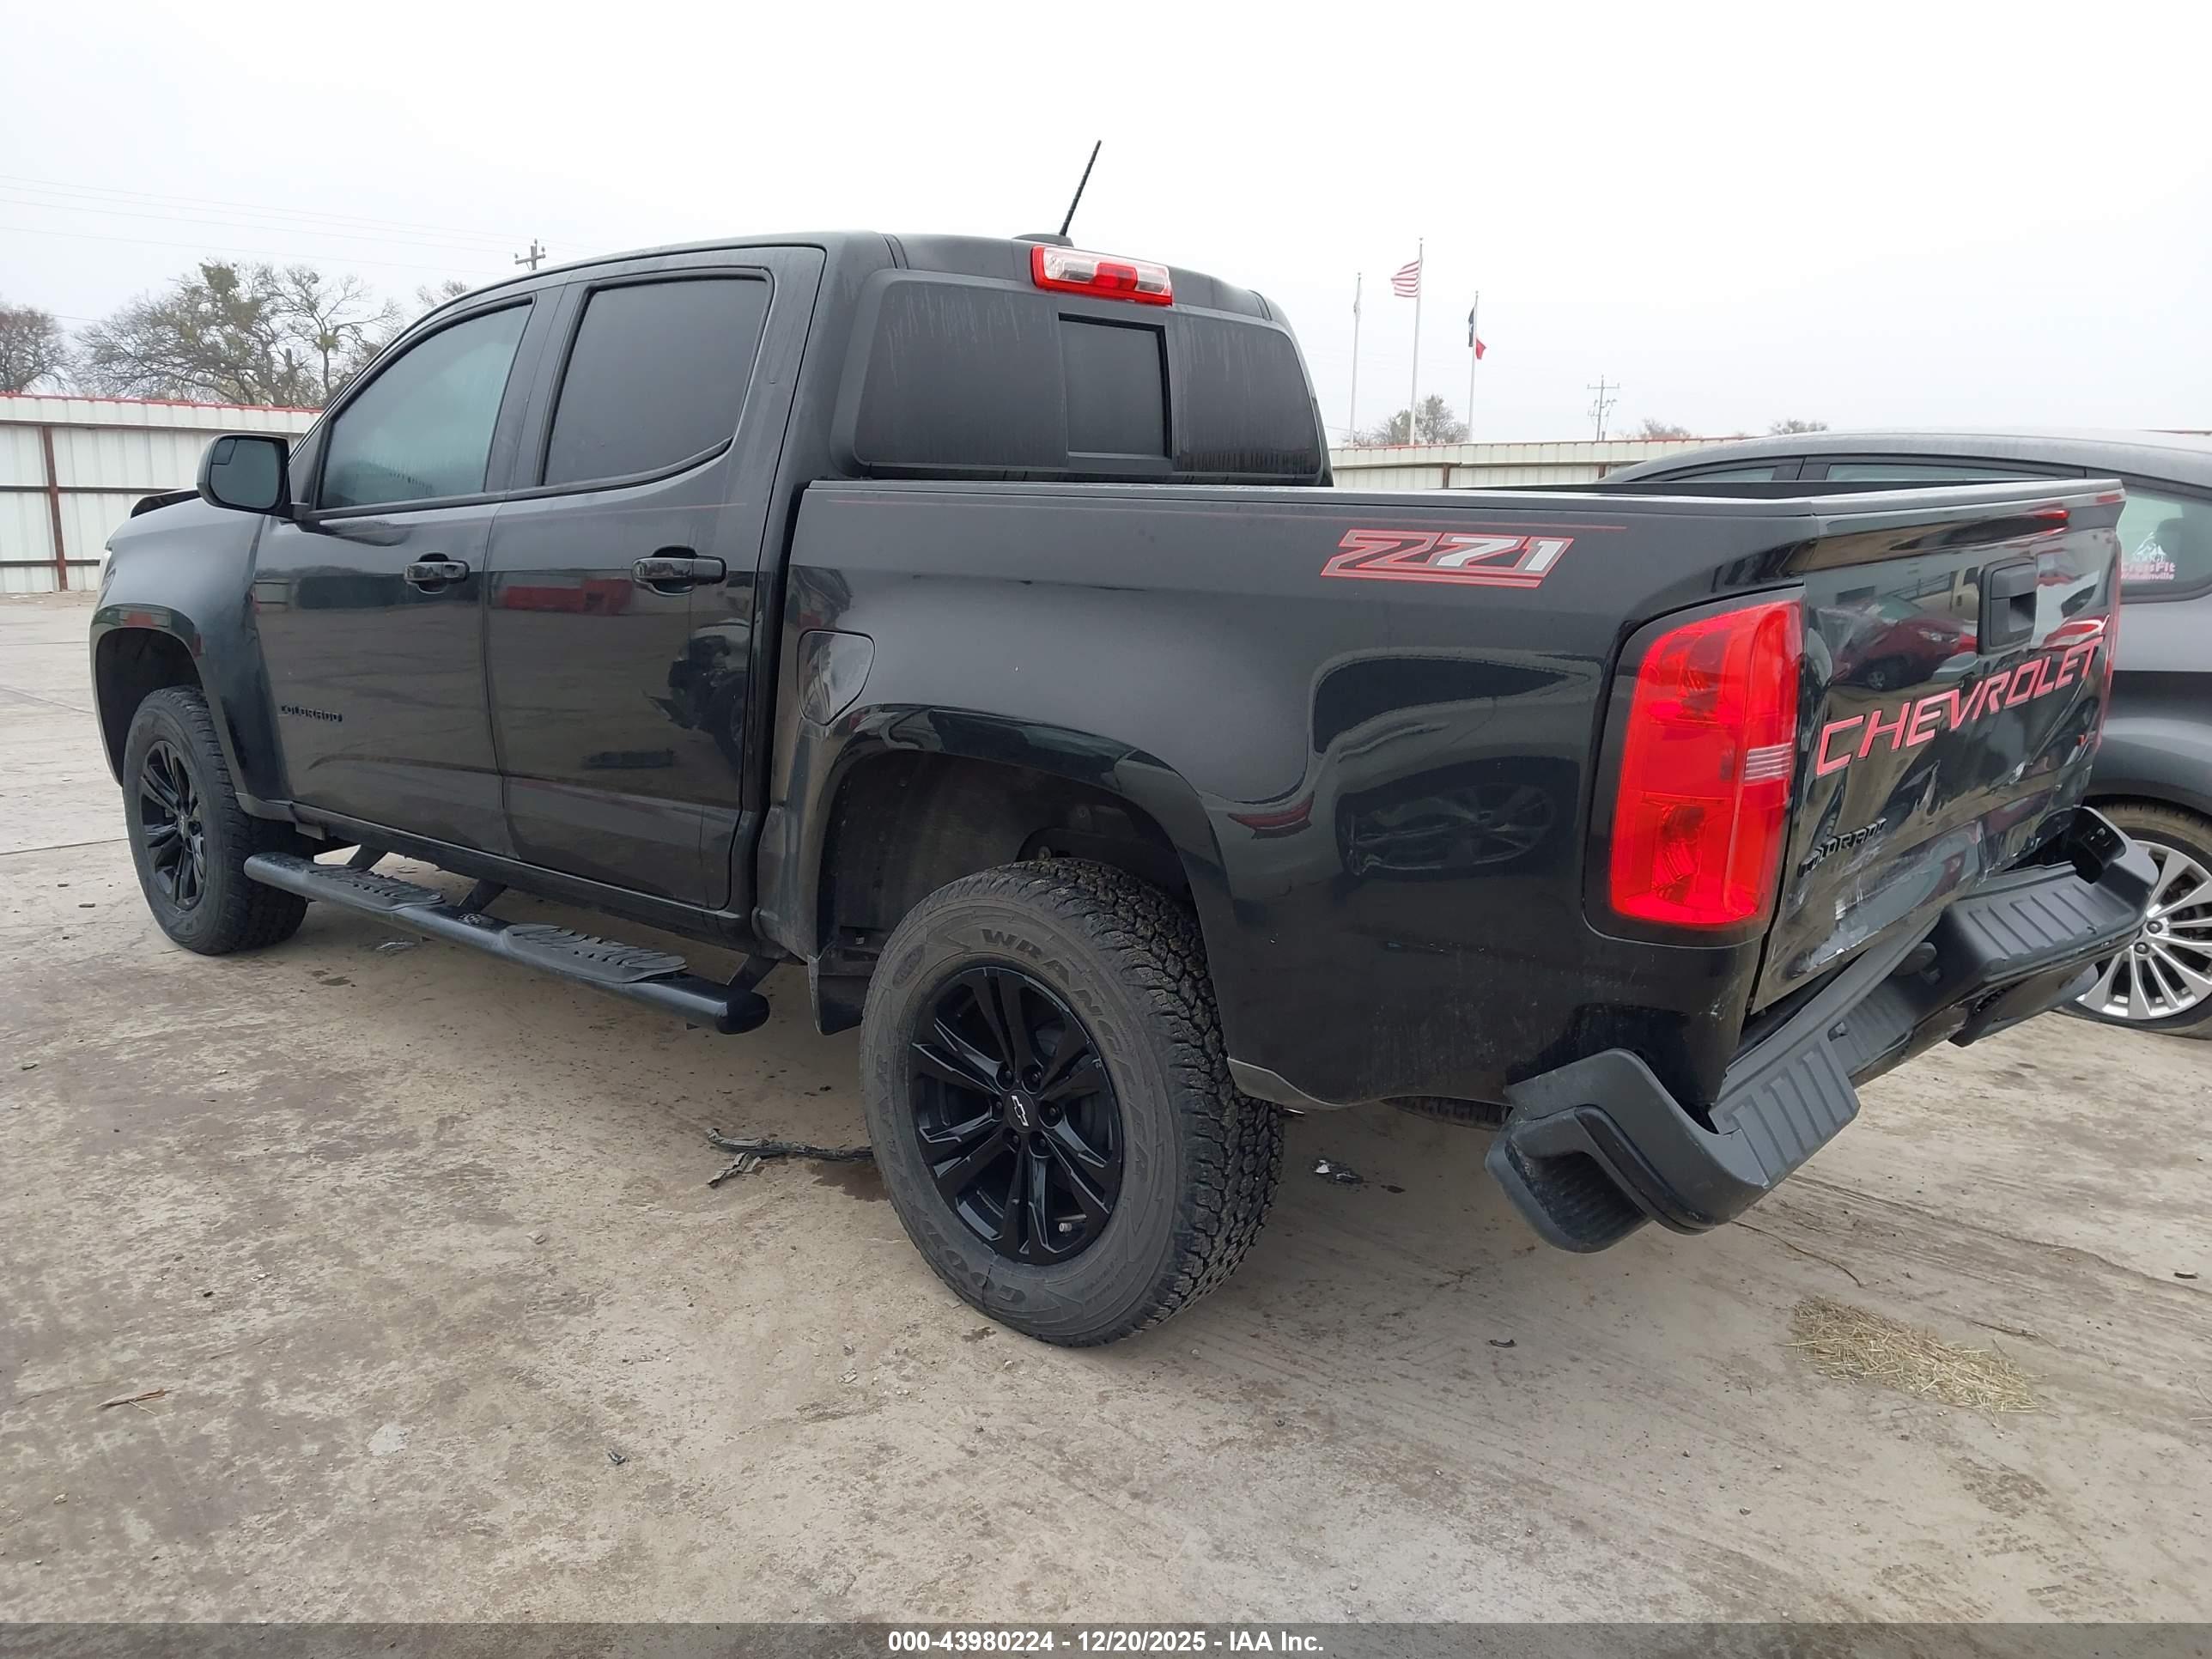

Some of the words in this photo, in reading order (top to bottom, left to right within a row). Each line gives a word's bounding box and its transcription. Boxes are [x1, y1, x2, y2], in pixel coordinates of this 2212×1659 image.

[1320, 528, 1574, 589] Z71
[280, 705, 343, 722] COLORADO
[1816, 635, 2105, 776] CHEVROLET
[1797, 817, 1889, 878] COLORADO
